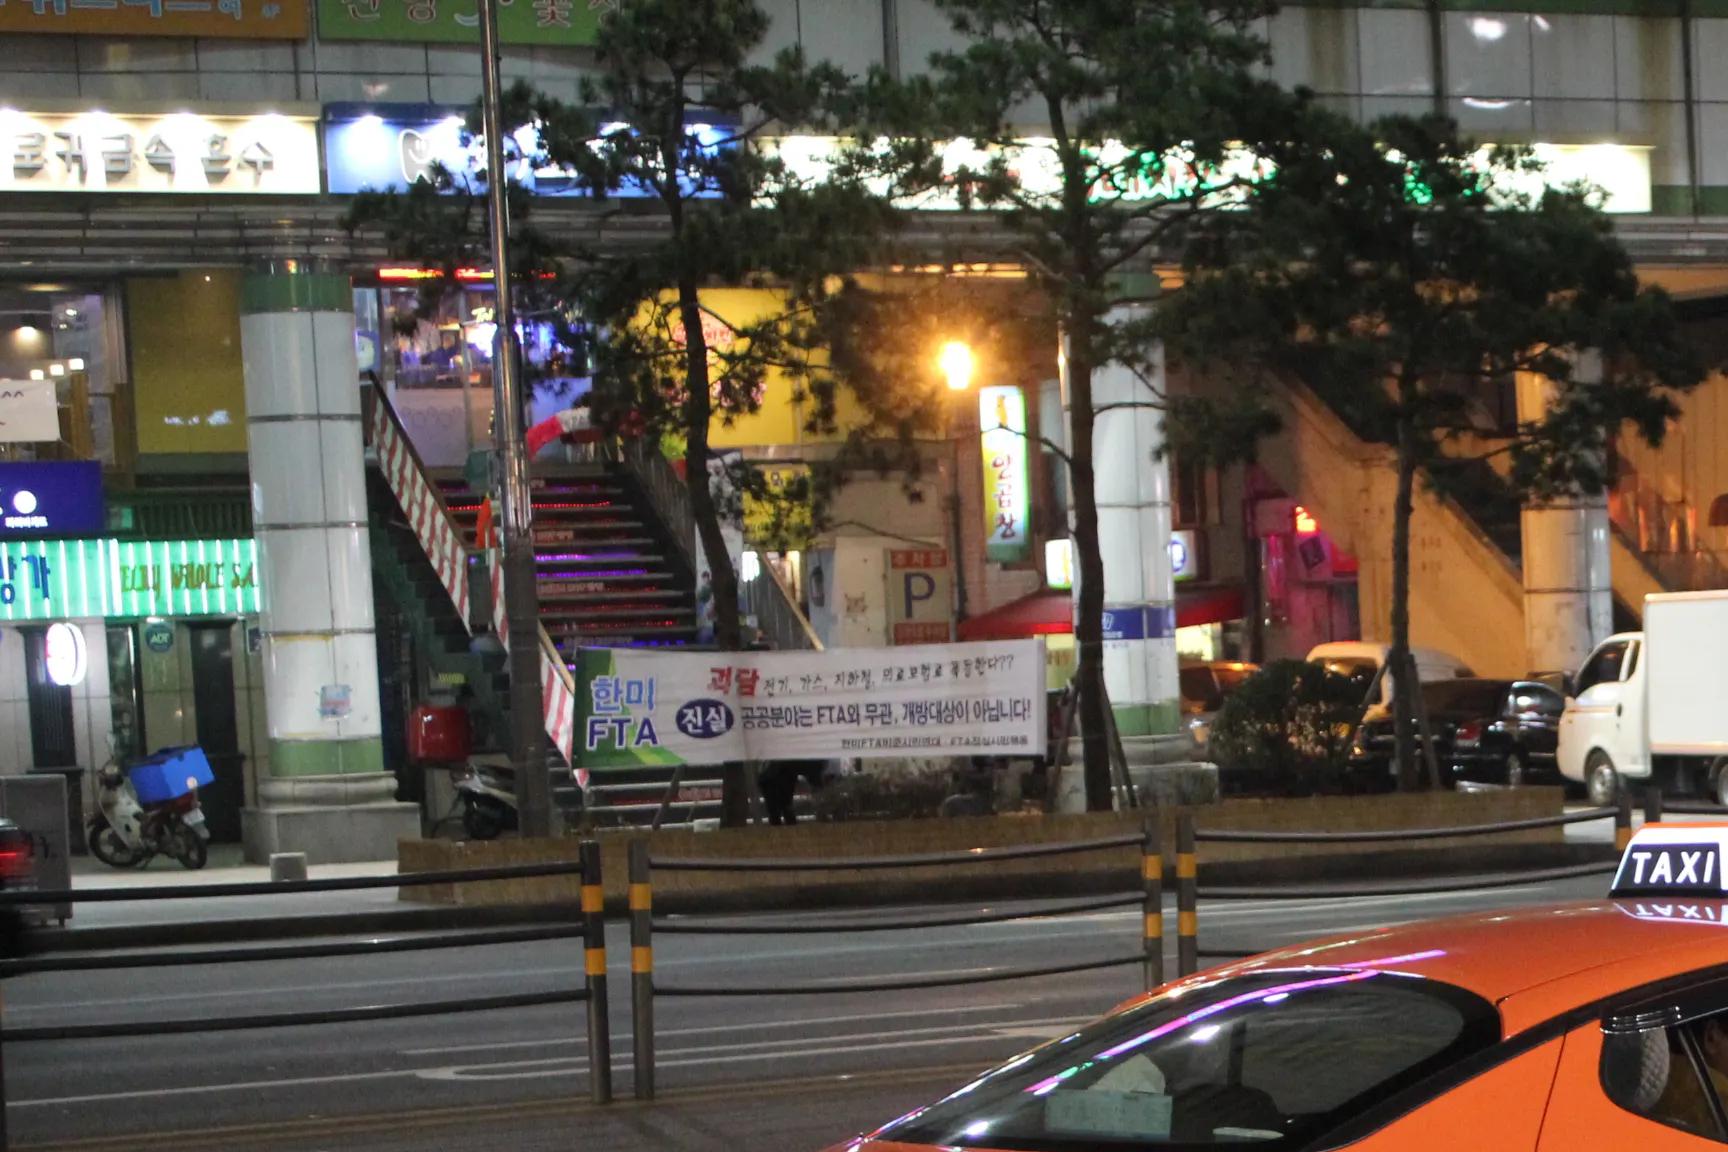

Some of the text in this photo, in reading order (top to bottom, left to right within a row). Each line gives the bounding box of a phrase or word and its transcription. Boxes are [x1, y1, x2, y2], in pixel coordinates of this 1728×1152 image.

[903, 571, 936, 619] P
[592, 676, 655, 713] 한미
[587, 716, 660, 748] FTA
[681, 698, 1032, 734] 진실 공공분야는 FTA와 무관, 개방대상이 아닙니다!
[1631, 850, 1715, 885] TAXI
